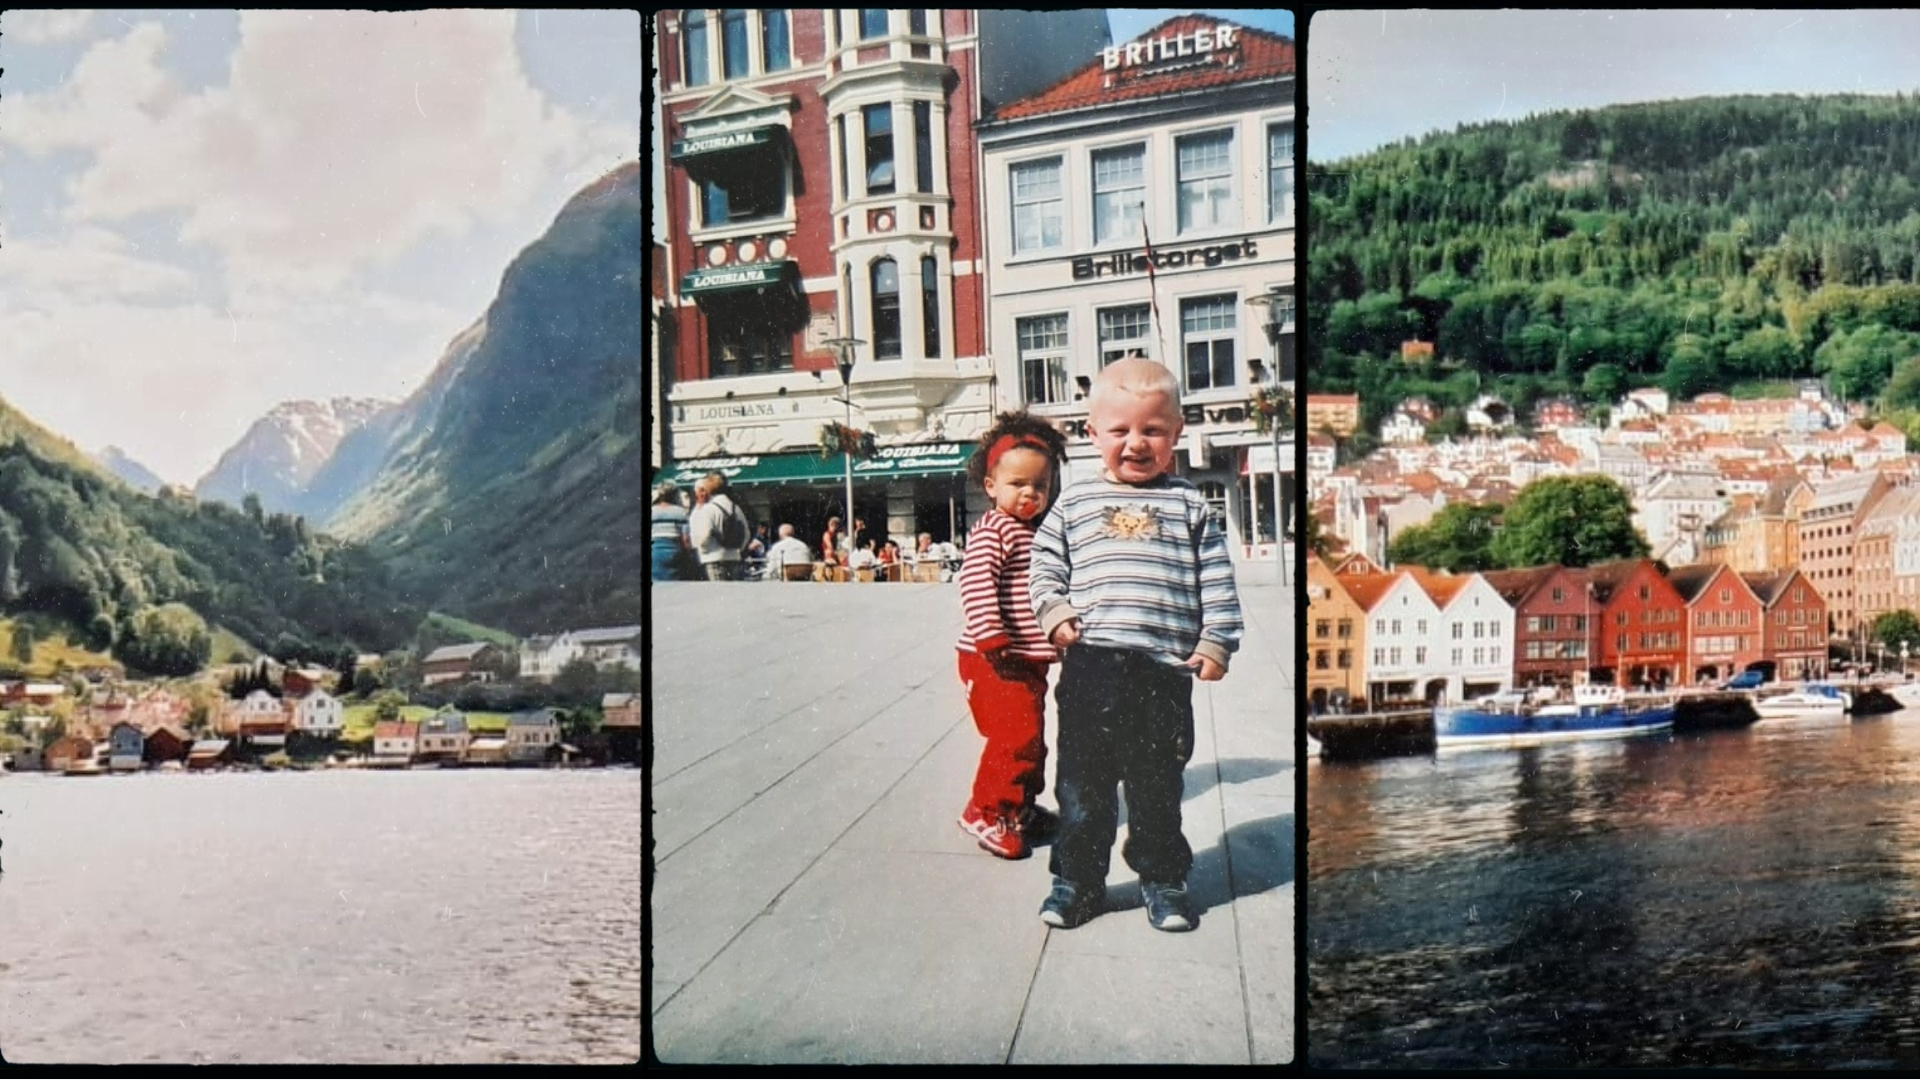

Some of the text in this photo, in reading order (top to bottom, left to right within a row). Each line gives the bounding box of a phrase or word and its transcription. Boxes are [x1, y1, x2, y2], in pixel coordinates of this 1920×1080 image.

[1103, 25, 1233, 70] BRILLER
[683, 133, 755, 154] LOUISIANA
[1072, 239, 1258, 281] Brilletorget
[693, 270, 765, 288] LOUISIANA
[700, 404, 774, 420] LOUISIANA
